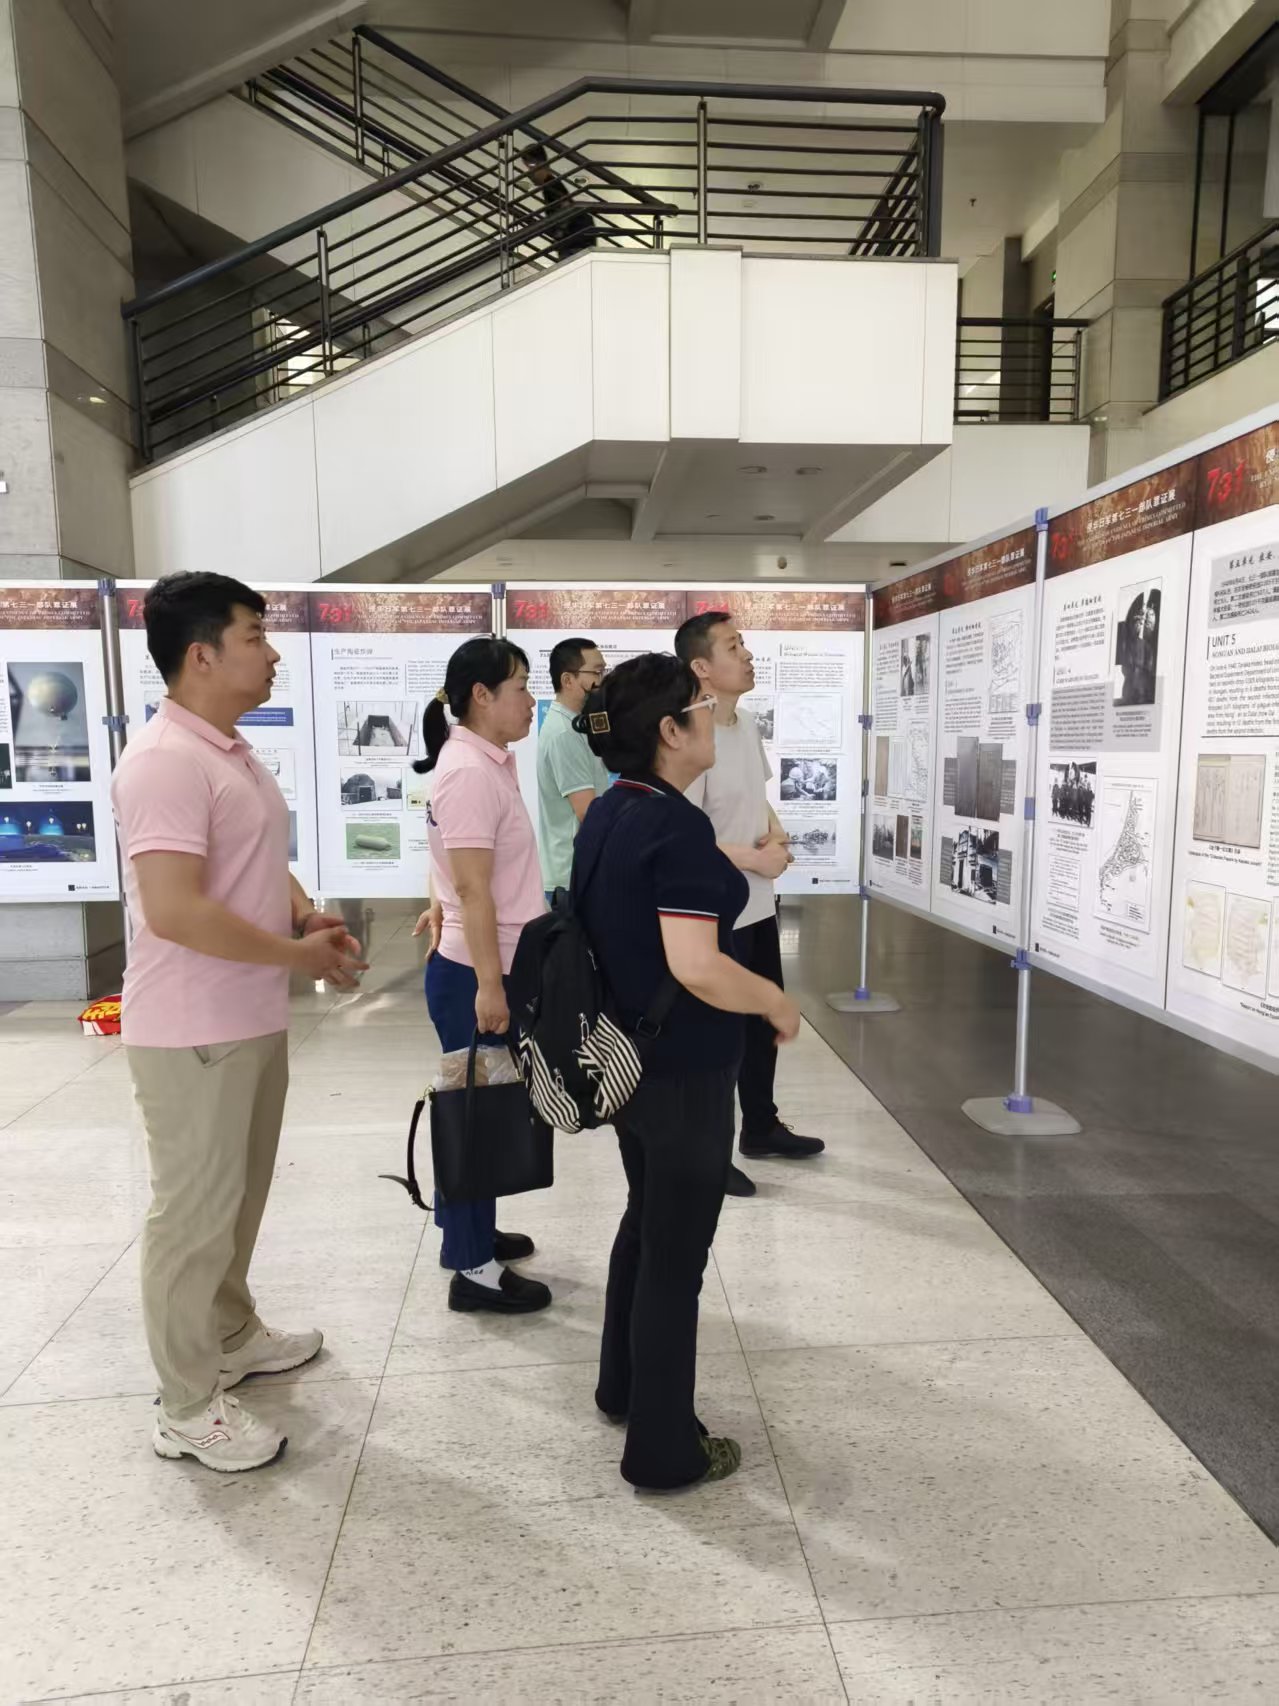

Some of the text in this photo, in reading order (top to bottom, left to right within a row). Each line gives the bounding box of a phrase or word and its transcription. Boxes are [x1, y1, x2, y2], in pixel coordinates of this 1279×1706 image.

[1207, 460, 1246, 503] 731
[0, 601, 78, 609] 第七三一部队罪证展
[1212, 633, 1236, 647] UNIT 5
